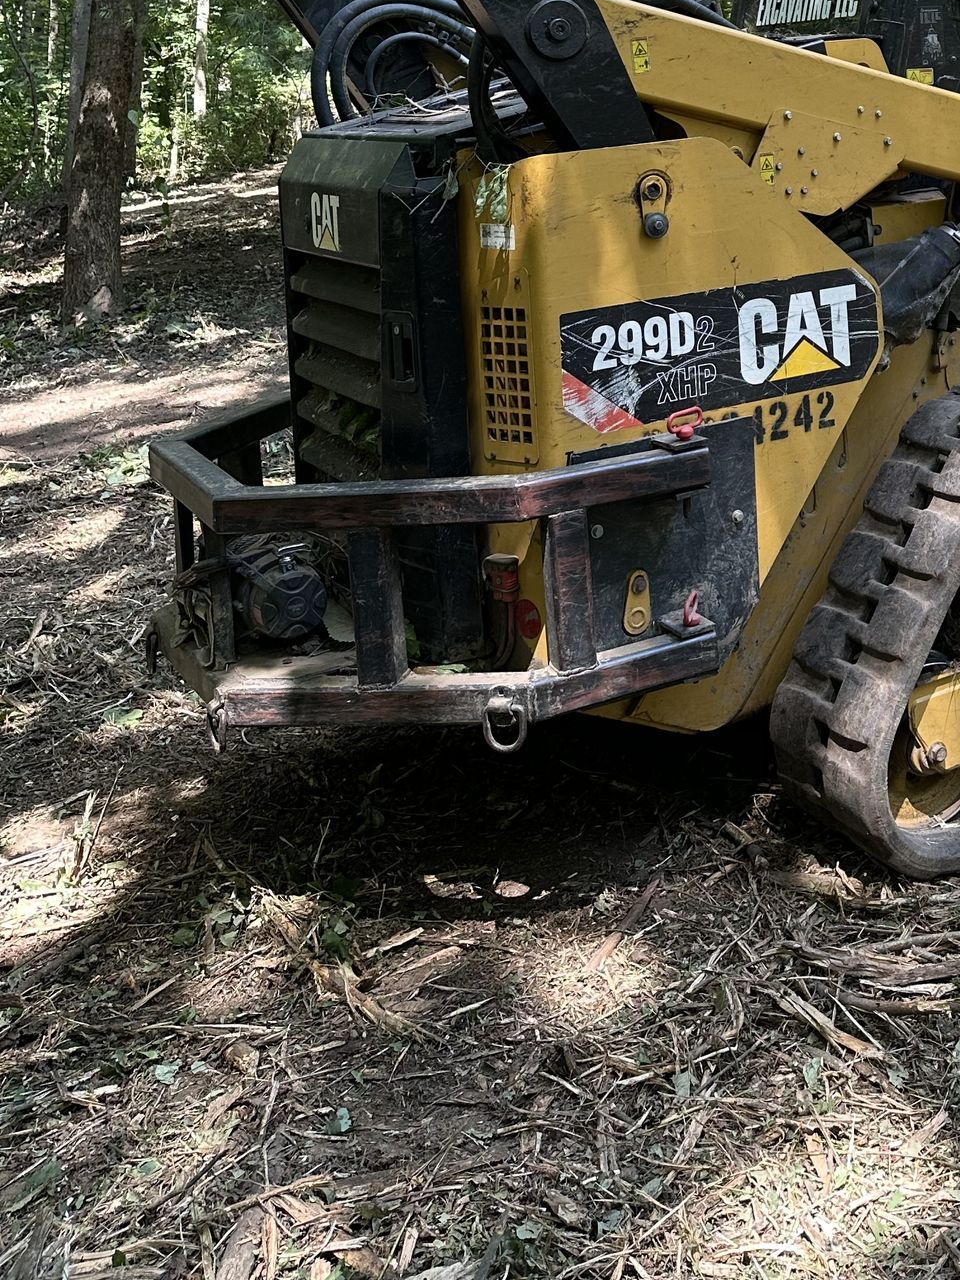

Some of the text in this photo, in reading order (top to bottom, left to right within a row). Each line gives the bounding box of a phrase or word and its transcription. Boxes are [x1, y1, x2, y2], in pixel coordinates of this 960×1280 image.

[310, 191, 340, 252] CAT
[591, 311, 715, 371] 299D2
[738, 284, 857, 385] CAT
[657, 363, 717, 405] XHP
